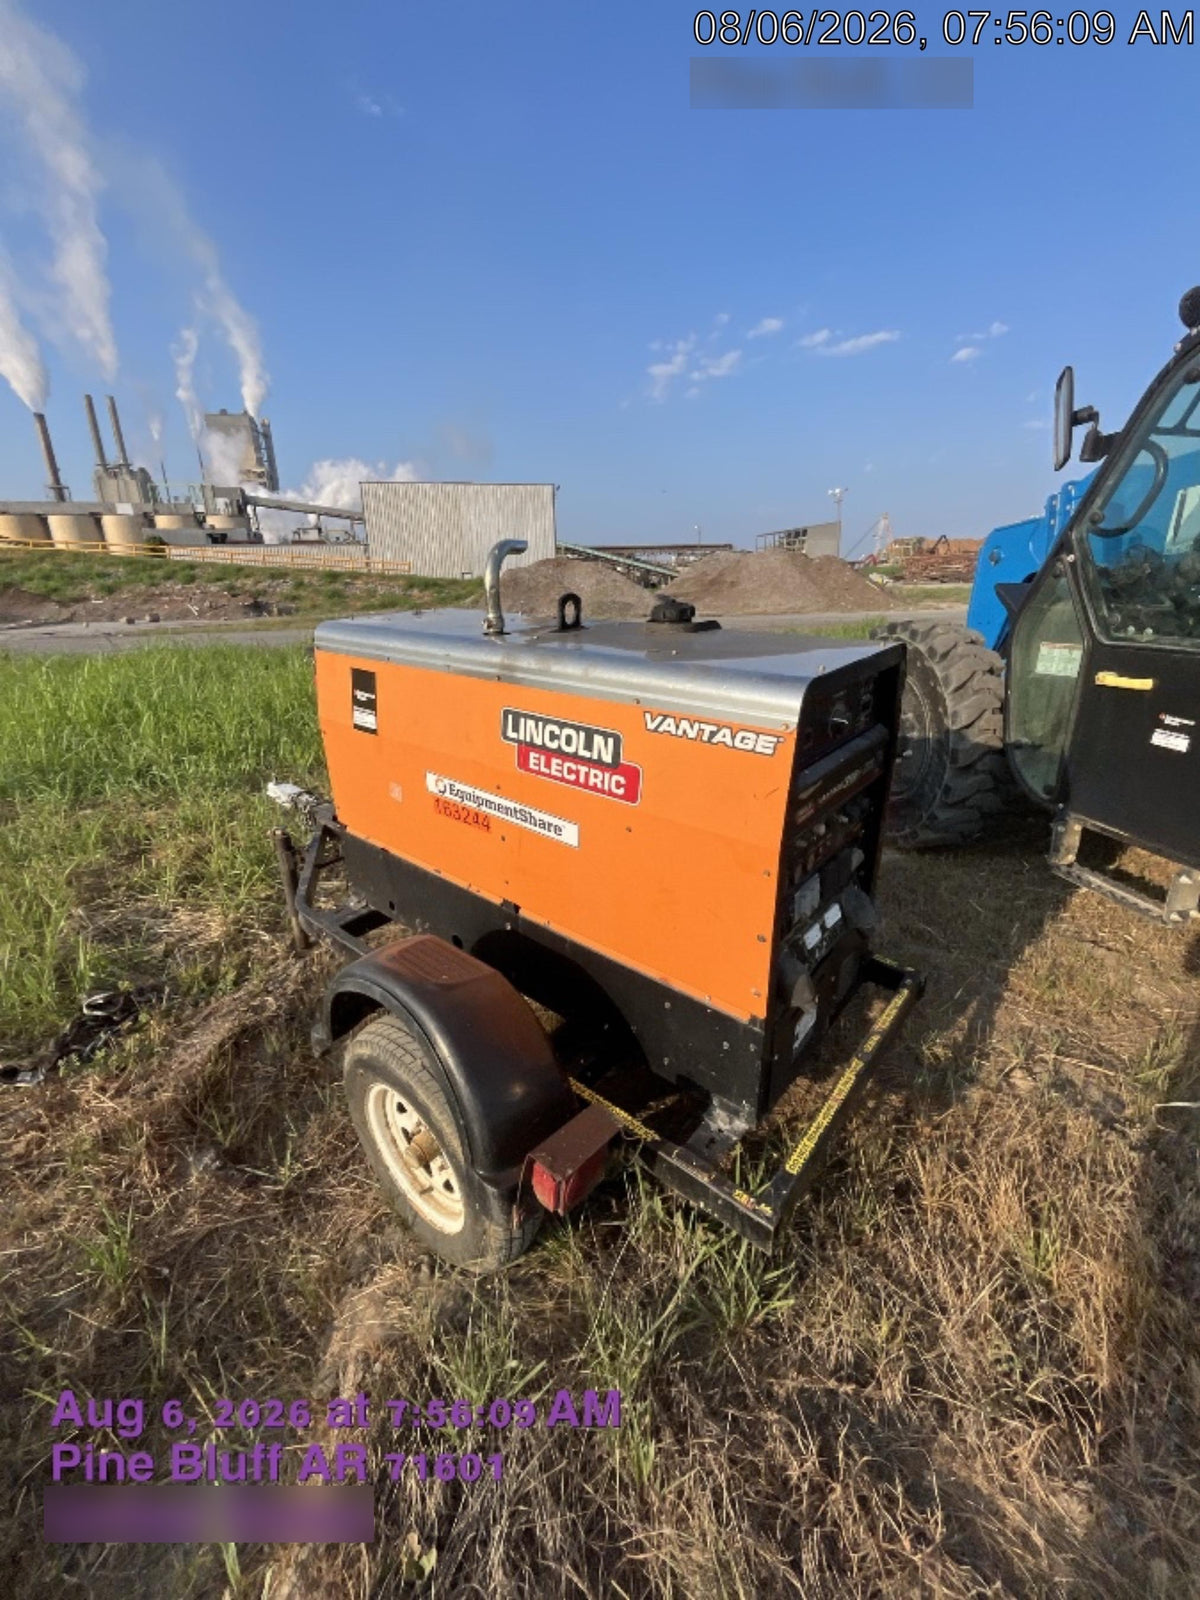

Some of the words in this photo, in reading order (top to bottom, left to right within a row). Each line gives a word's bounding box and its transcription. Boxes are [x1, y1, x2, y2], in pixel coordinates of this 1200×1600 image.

[506, 713, 615, 764] LINCOLN
[644, 711, 778, 756] VANTAGE
[528, 751, 627, 796] ELECTRIC
[433, 797, 492, 833] 163244
[448, 781, 564, 837] EquipmentShare
